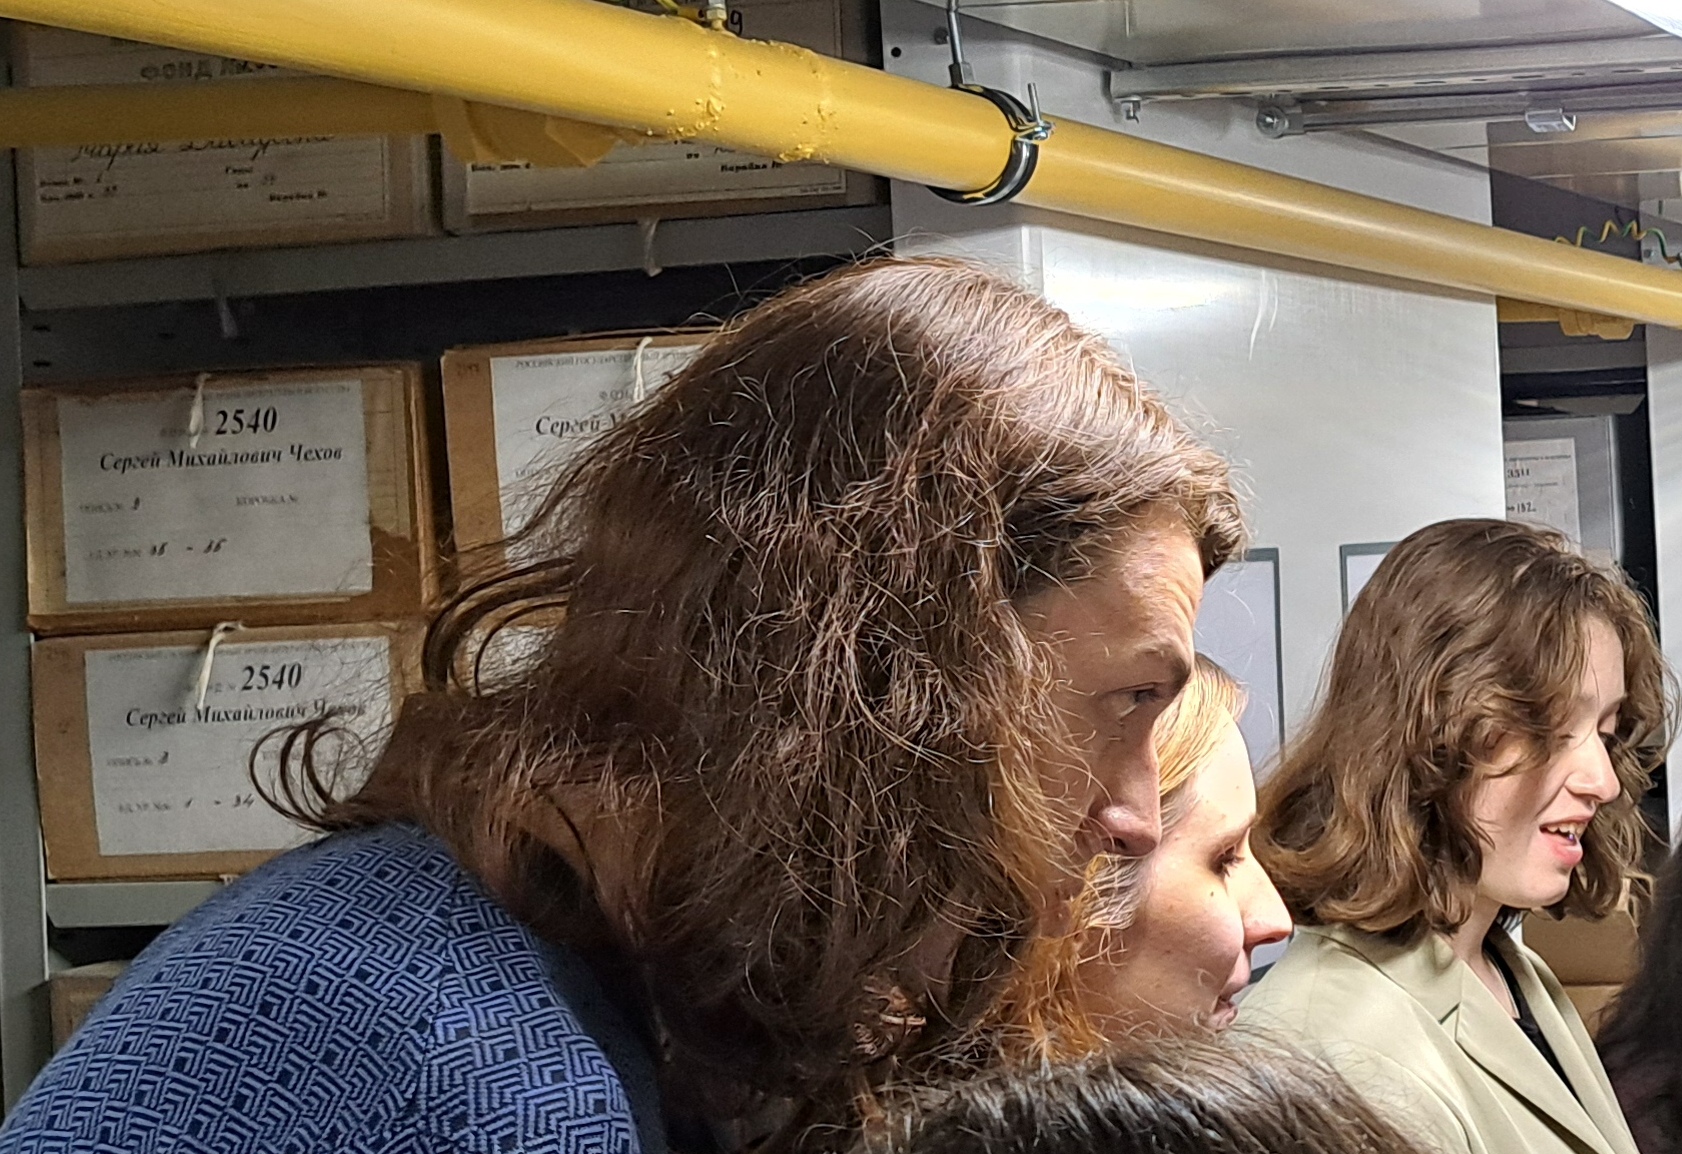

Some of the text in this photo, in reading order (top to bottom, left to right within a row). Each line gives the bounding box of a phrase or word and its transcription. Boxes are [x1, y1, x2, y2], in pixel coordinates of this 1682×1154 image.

[215, 405, 279, 435] 2540
[535, 414, 602, 438] Сергей
[100, 444, 343, 474] Сергей Михайлович Чехов
[241, 662, 302, 691] 2540
[126, 707, 187, 729] Сергей
[194, 704, 307, 725] Михайлович
